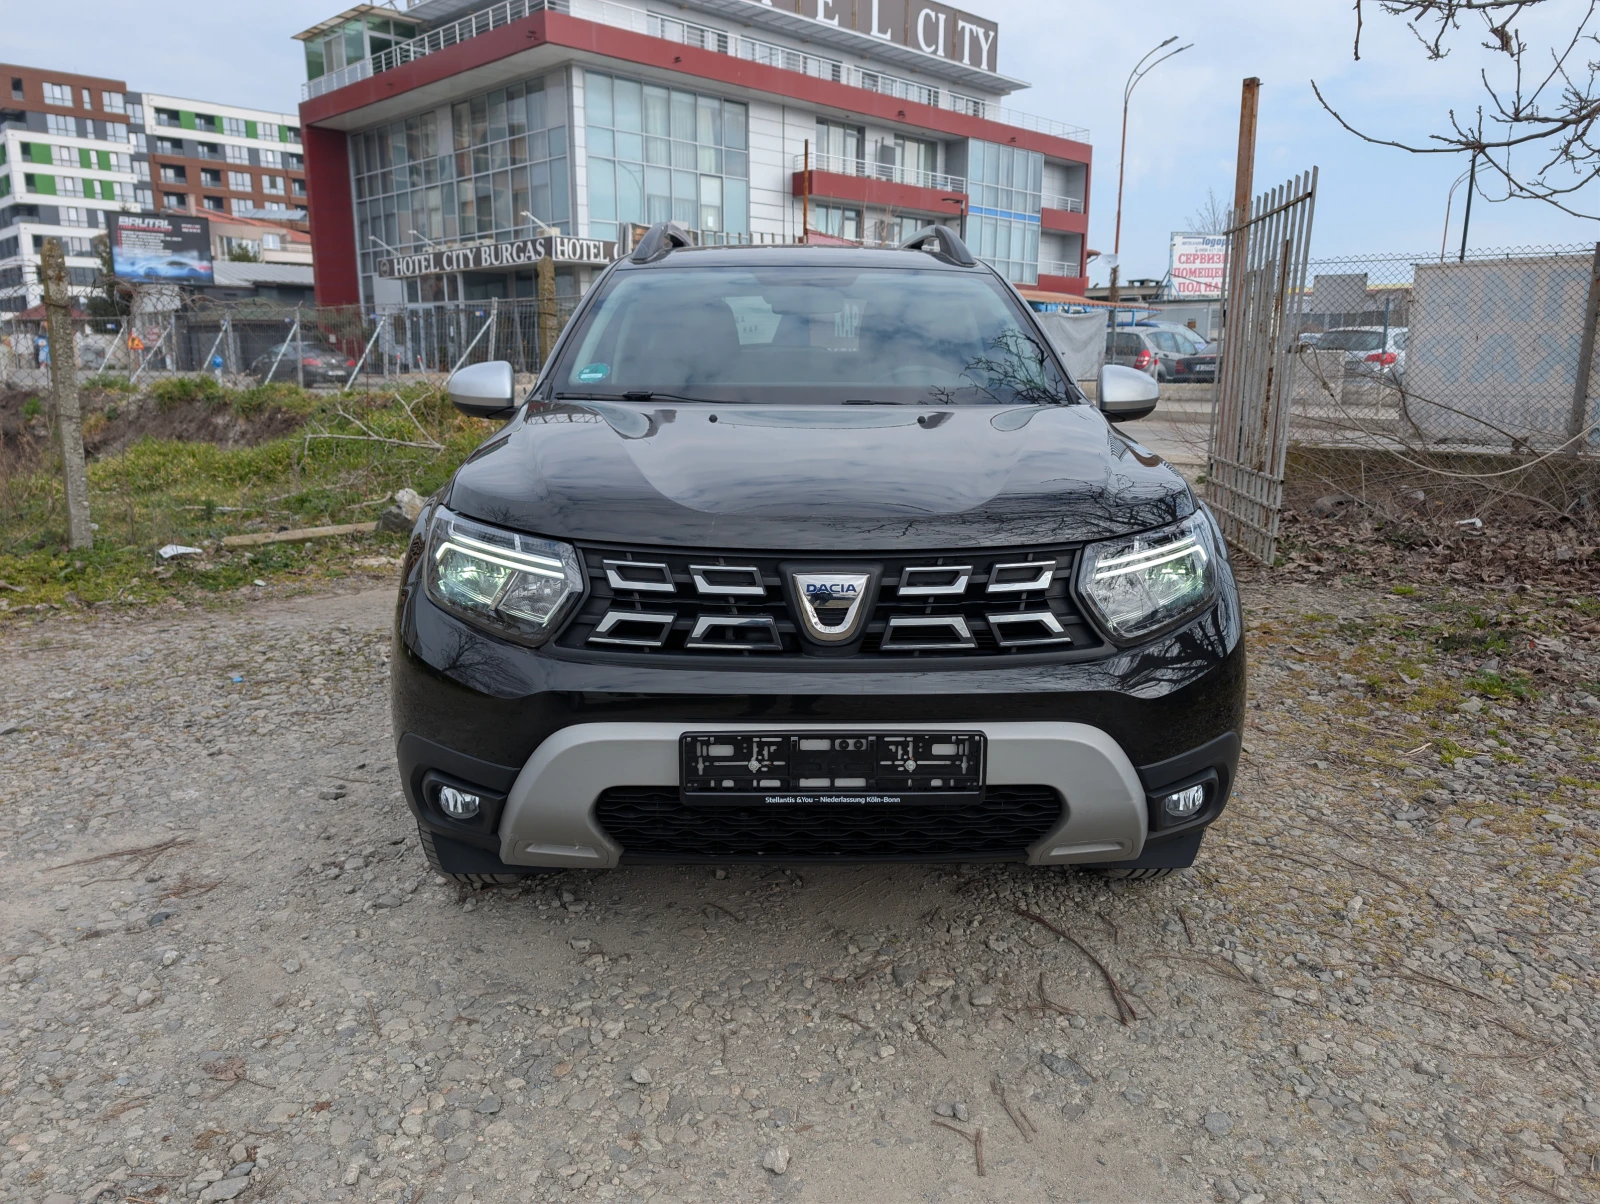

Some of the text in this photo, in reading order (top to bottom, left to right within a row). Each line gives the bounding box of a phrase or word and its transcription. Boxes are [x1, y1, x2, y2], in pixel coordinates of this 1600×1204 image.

[917, 8, 995, 70] CITY
[118, 216, 173, 229] BRUTAL
[556, 238, 610, 261] HOTEL
[394, 239, 545, 276] HOTEL CITY BURGAS
[1178, 282, 1222, 295] ПОД НА
[806, 583, 857, 593] DACIA
[820, 796, 865, 805] Niederlassung
